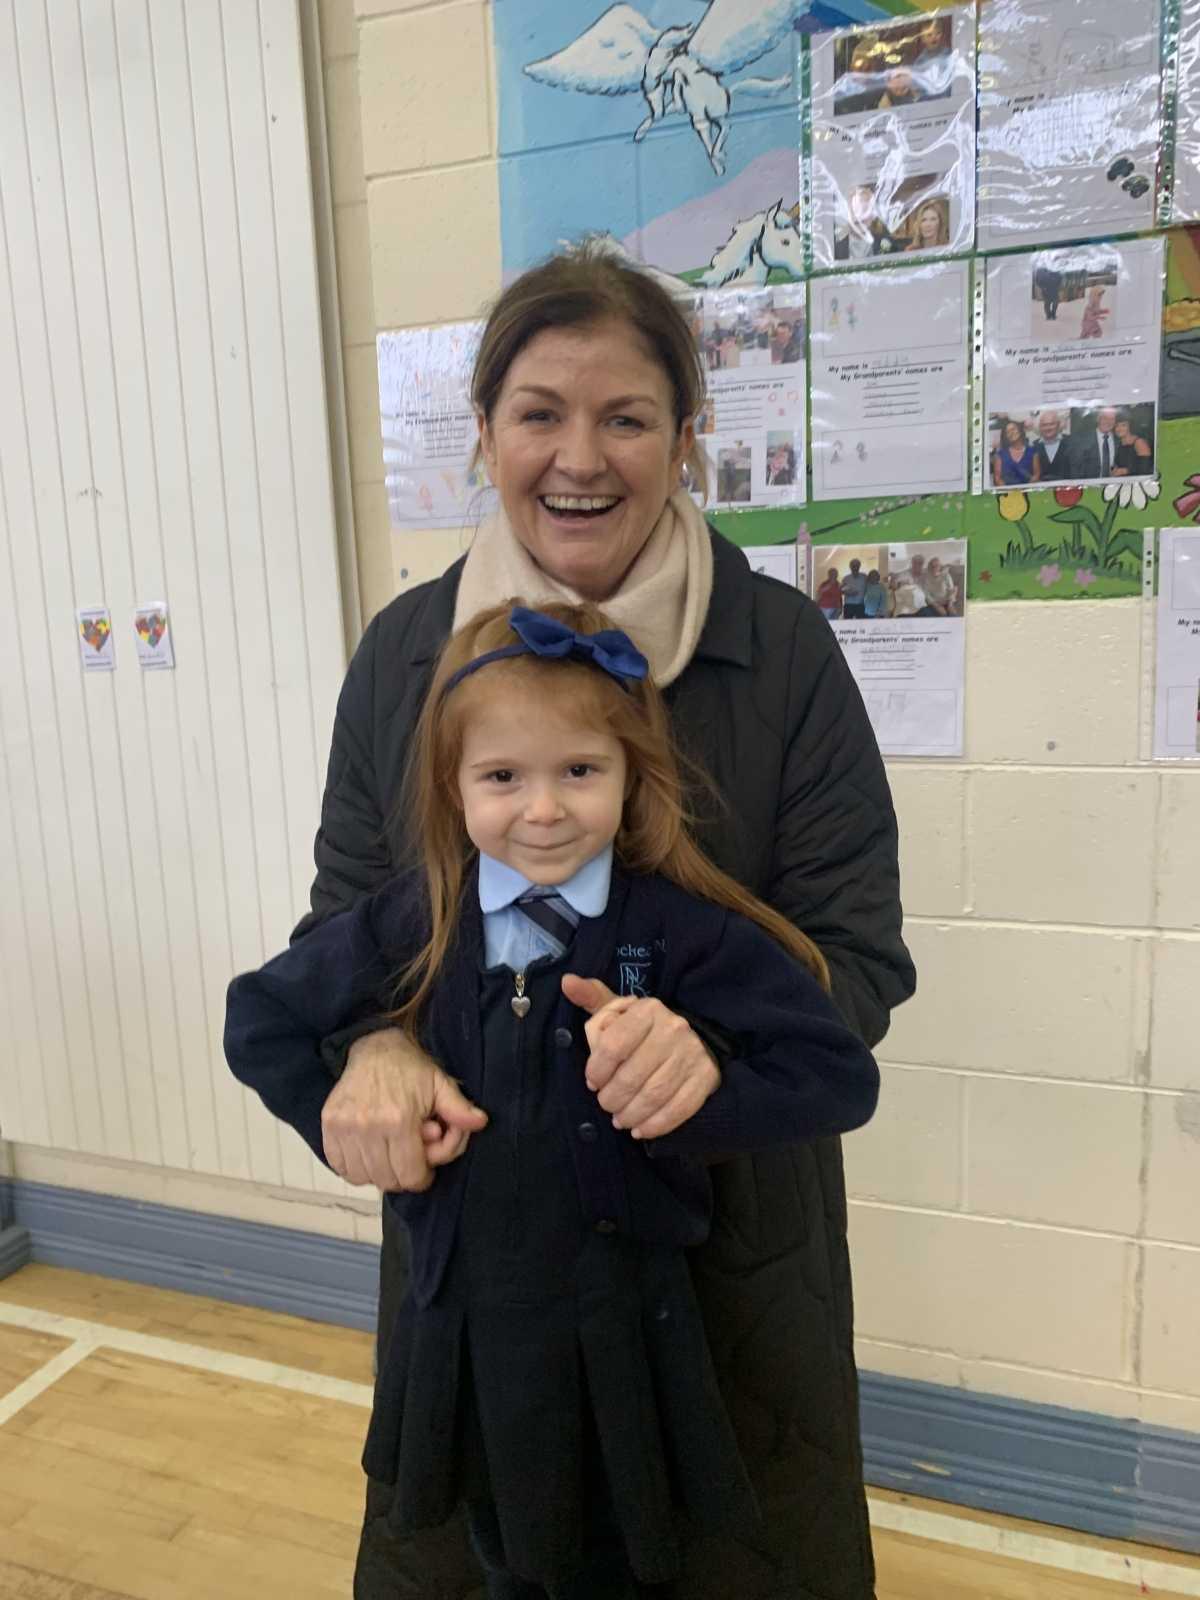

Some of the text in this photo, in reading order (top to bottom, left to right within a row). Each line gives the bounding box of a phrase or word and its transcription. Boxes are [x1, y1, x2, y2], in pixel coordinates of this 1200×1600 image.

[1005, 348, 1017, 357] My
[1018, 357, 1030, 365] My
[1033, 353, 1086, 364] Grandparents'
[828, 364, 839, 374] My
[840, 373, 851, 382] My
[854, 368, 902, 380] Grandparents'
[905, 366, 928, 375] names
[1178, 617, 1190, 628] My
[901, 635, 924, 643] names
[926, 635, 939, 643] are
